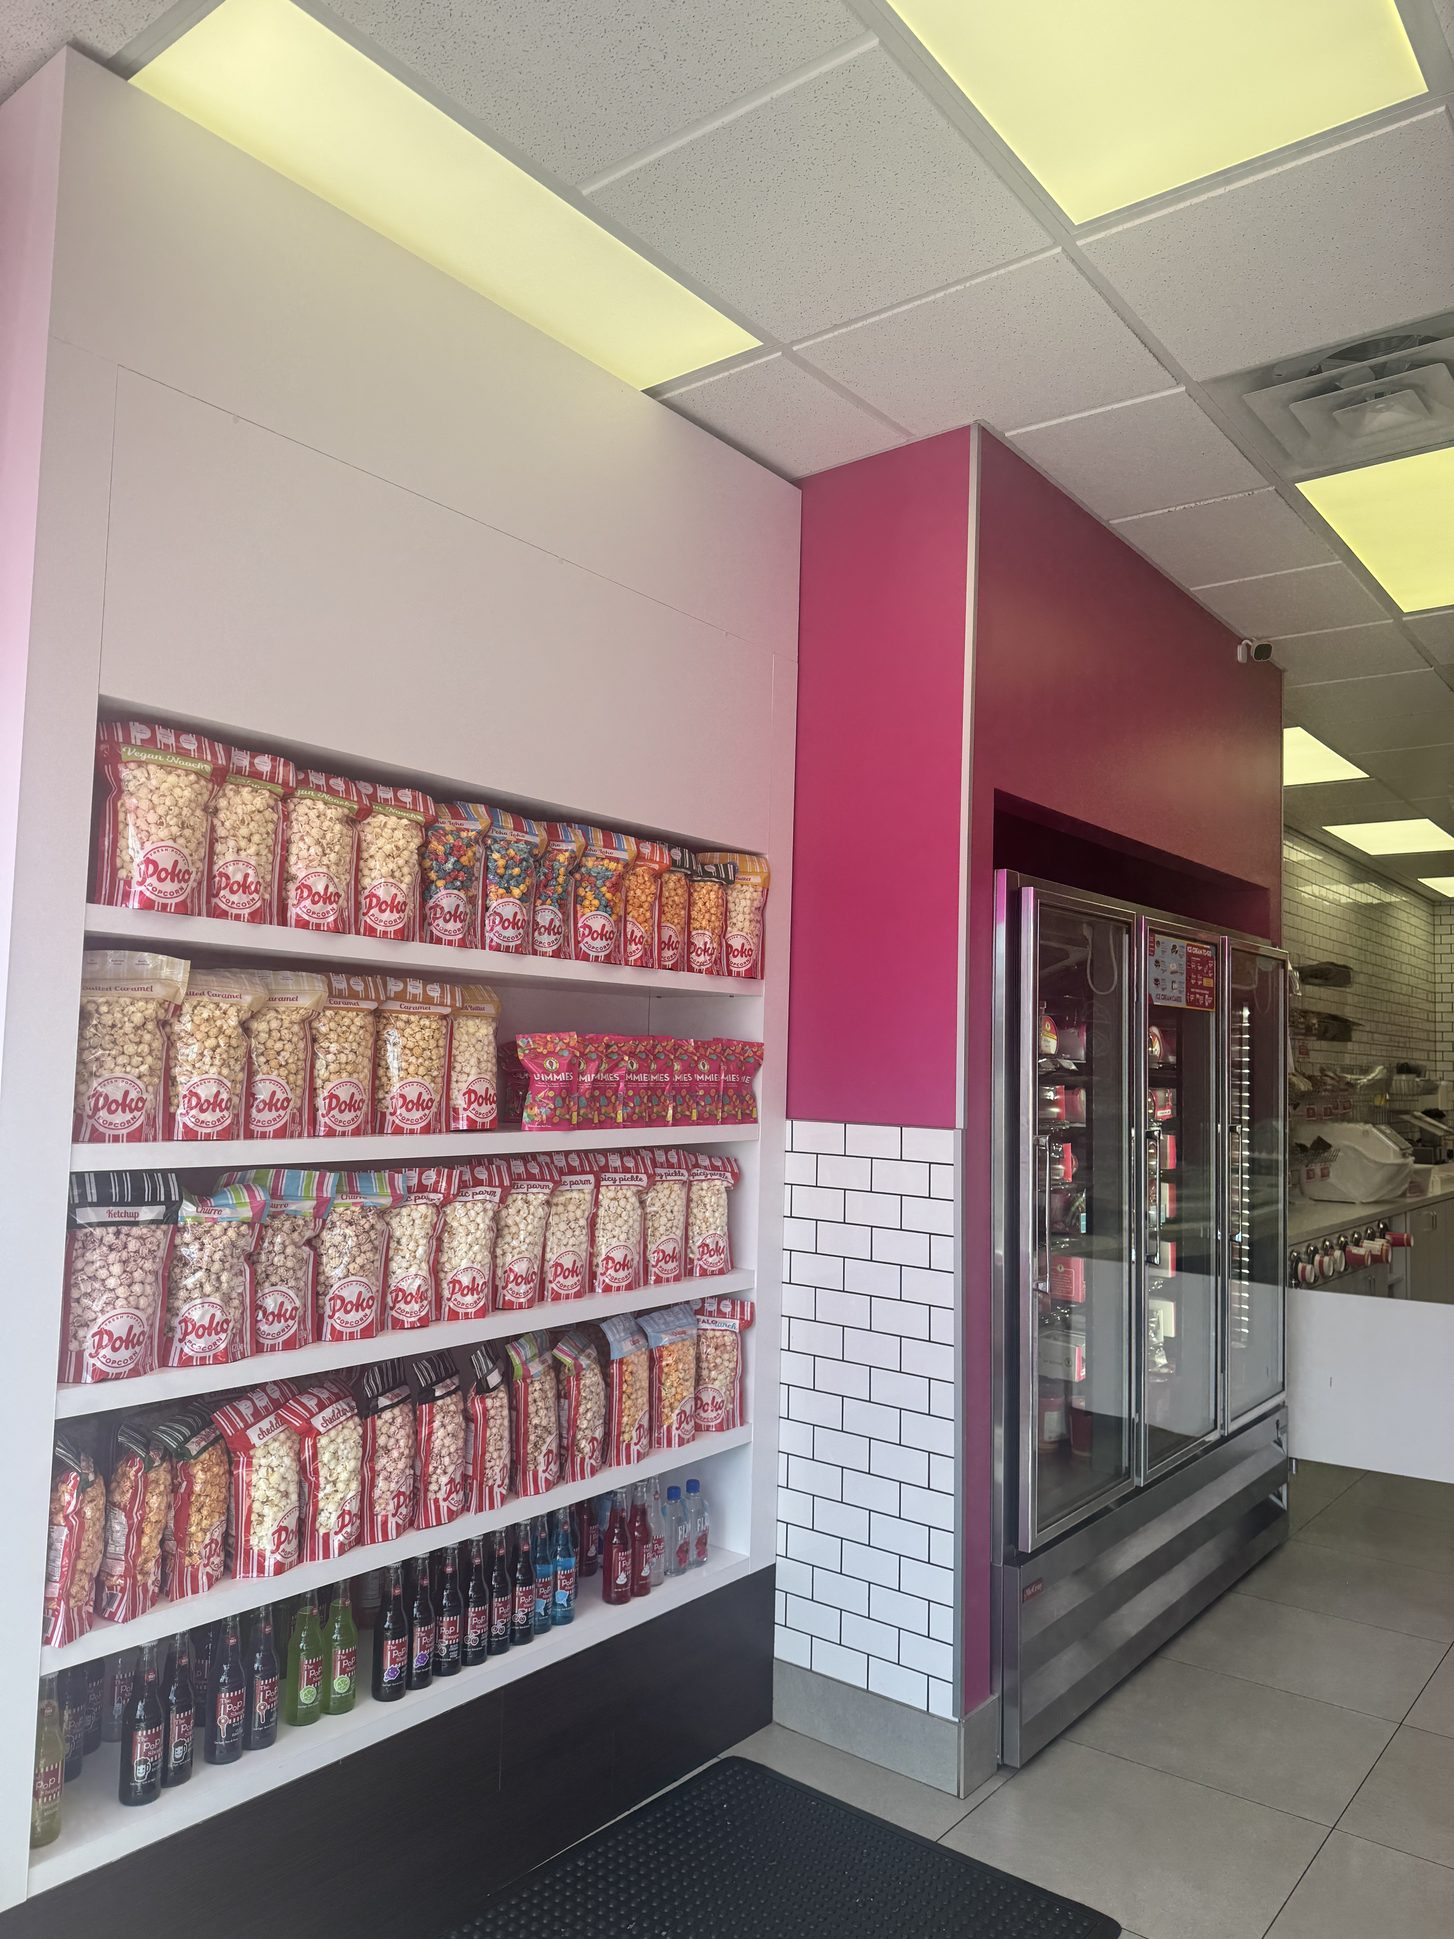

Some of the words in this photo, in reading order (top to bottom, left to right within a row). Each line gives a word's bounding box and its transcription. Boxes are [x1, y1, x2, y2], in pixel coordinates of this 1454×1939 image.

[122, 746, 164, 761] Vegan
[136, 857, 193, 886] Poko
[147, 882, 185, 897] POPCORN
[212, 871, 261, 898] Poko
[221, 894, 255, 908] POPCORN
[292, 882, 341, 909] Poko
[362, 891, 408, 917] Poko
[302, 905, 336, 919] POPCORN
[370, 912, 403, 925] POPCORN
[578, 923, 615, 945] Poko
[627, 931, 644, 946] ko
[585, 940, 611, 952] POPCORN
[661, 934, 680, 950] oko
[661, 952, 677, 961] PCORN
[114, 985, 153, 993] Caramel
[207, 991, 242, 1000] Caramel
[329, 999, 360, 1007] Caramel
[400, 1003, 431, 1011] Caramel
[87, 1089, 147, 1119] Poko
[180, 1090, 231, 1118] Poko
[321, 1092, 365, 1118] Poko
[390, 1091, 435, 1117] Poko
[462, 1088, 496, 1111] Poko
[331, 1114, 359, 1125] POPCORN
[399, 1112, 428, 1124] POPCORN
[471, 1107, 495, 1118] POPCORN
[97, 1115, 137, 1128] POPCORN
[190, 1114, 227, 1126] POPCORN
[250, 1114, 282, 1126] OPCORN
[618, 1174, 644, 1185] pickle
[664, 1169, 685, 1179] pickle
[527, 1183, 551, 1192] parm
[569, 1179, 592, 1188] parm
[472, 1190, 497, 1199] parm
[196, 1205, 224, 1216] Churro
[270, 1201, 289, 1209] urro
[106, 1208, 140, 1220] Ketchup
[651, 1246, 678, 1268] Pok
[502, 1266, 537, 1290] Poko
[548, 1258, 584, 1284] Poko
[607, 1272, 632, 1284] POPCORN
[447, 1276, 487, 1301] Poko
[556, 1278, 581, 1290] POPCORN
[509, 1286, 533, 1298] POPCORN
[328, 1291, 376, 1319] Poko
[453, 1296, 483, 1309] POPCORN
[396, 1303, 425, 1317] POPCORN
[105, 1315, 124, 1326] FRESH
[336, 1312, 369, 1325] POPCORN
[178, 1313, 232, 1344] Poko
[257, 1323, 291, 1338] POPCORN
[89, 1324, 146, 1358] Poko
[101, 1351, 138, 1366] POPCORN
[676, 1408, 695, 1431] Pok
[257, 1418, 284, 1440] chedd
[334, 1509, 360, 1536] Po
[271, 1525, 299, 1554] Po
